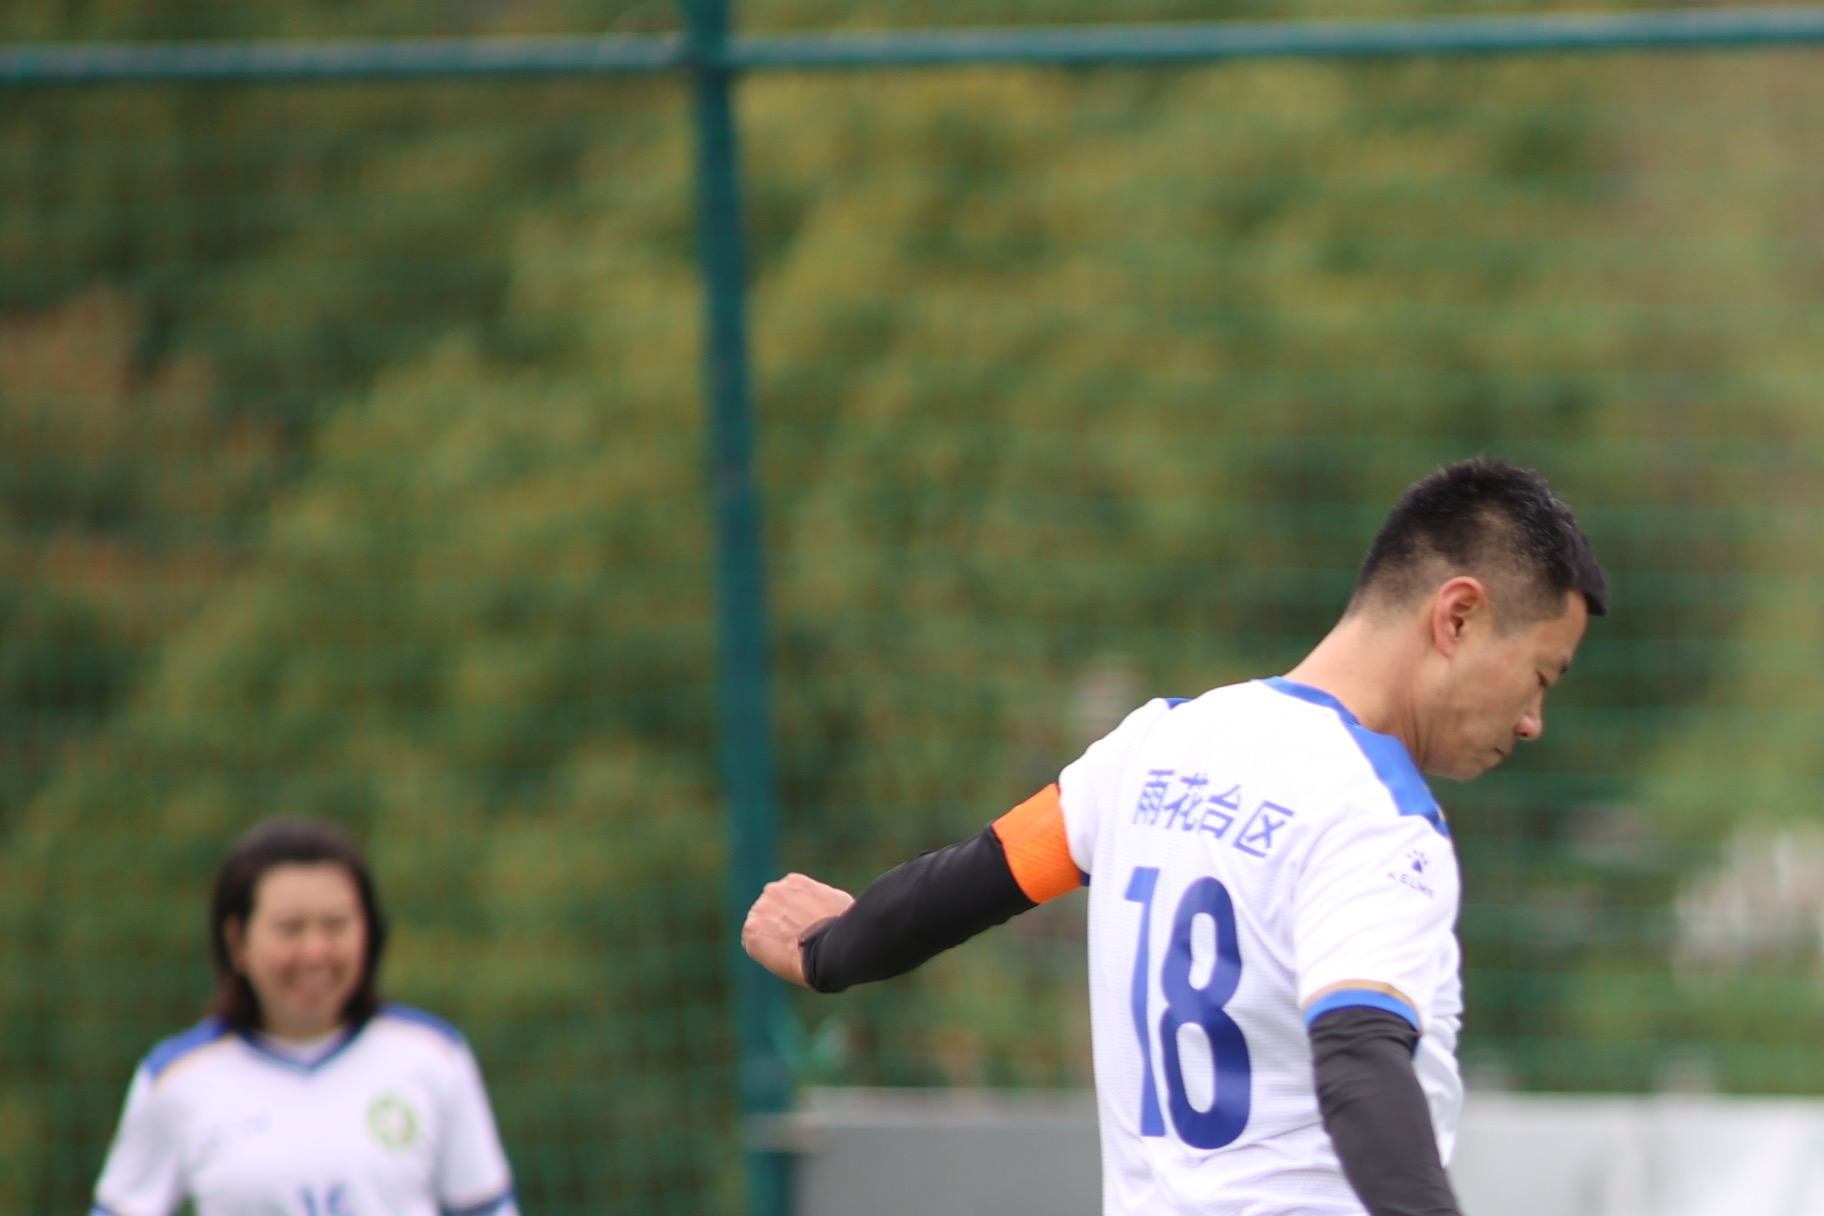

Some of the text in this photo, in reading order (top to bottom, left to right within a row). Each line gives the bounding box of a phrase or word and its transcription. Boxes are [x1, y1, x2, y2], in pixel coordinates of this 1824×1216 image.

[1131, 769, 1296, 858] 雨花台区
[1386, 871, 1437, 901] KELME
[1123, 866, 1252, 1150] 18
